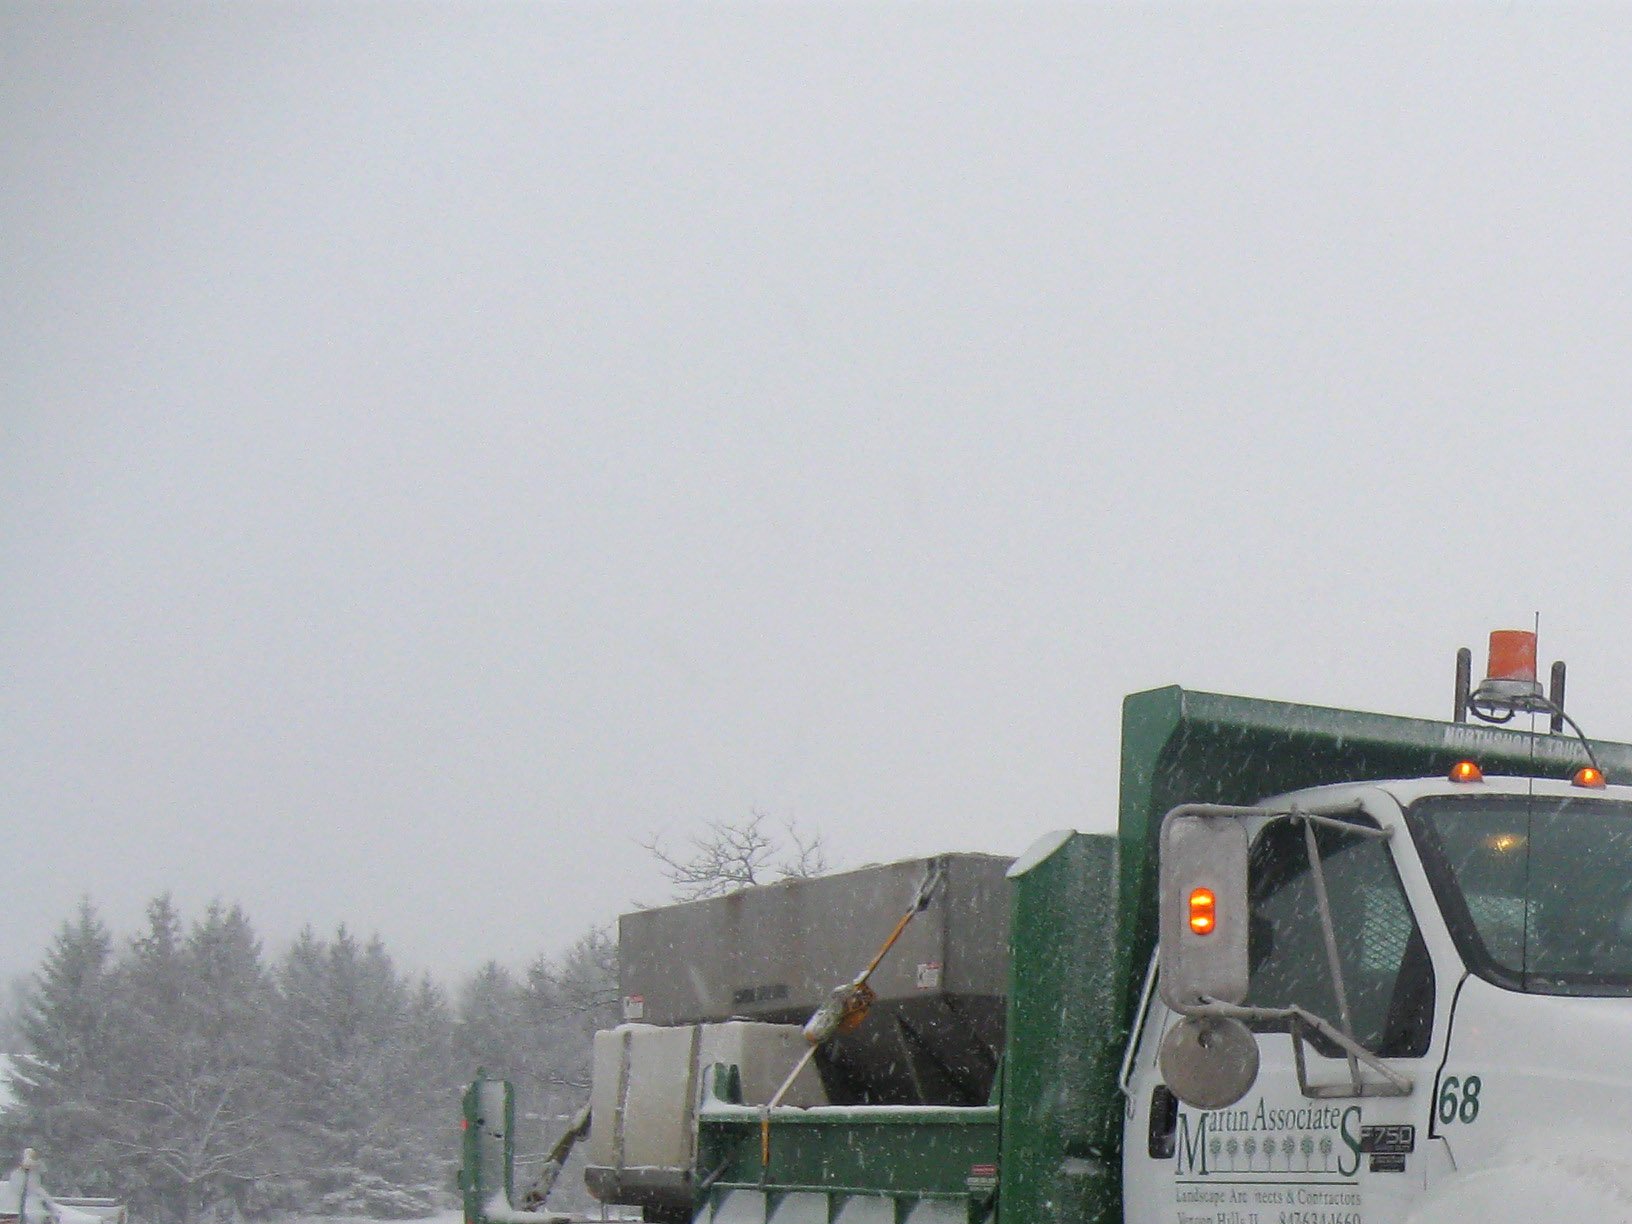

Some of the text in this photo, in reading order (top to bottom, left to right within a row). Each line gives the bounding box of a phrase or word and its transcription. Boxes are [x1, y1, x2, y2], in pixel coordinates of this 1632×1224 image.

[1438, 1075, 1482, 1124] 68
[1174, 1109, 1250, 1176] Martin
[1176, 1187, 1361, 1207] Landscape Arcitects & Contractors
